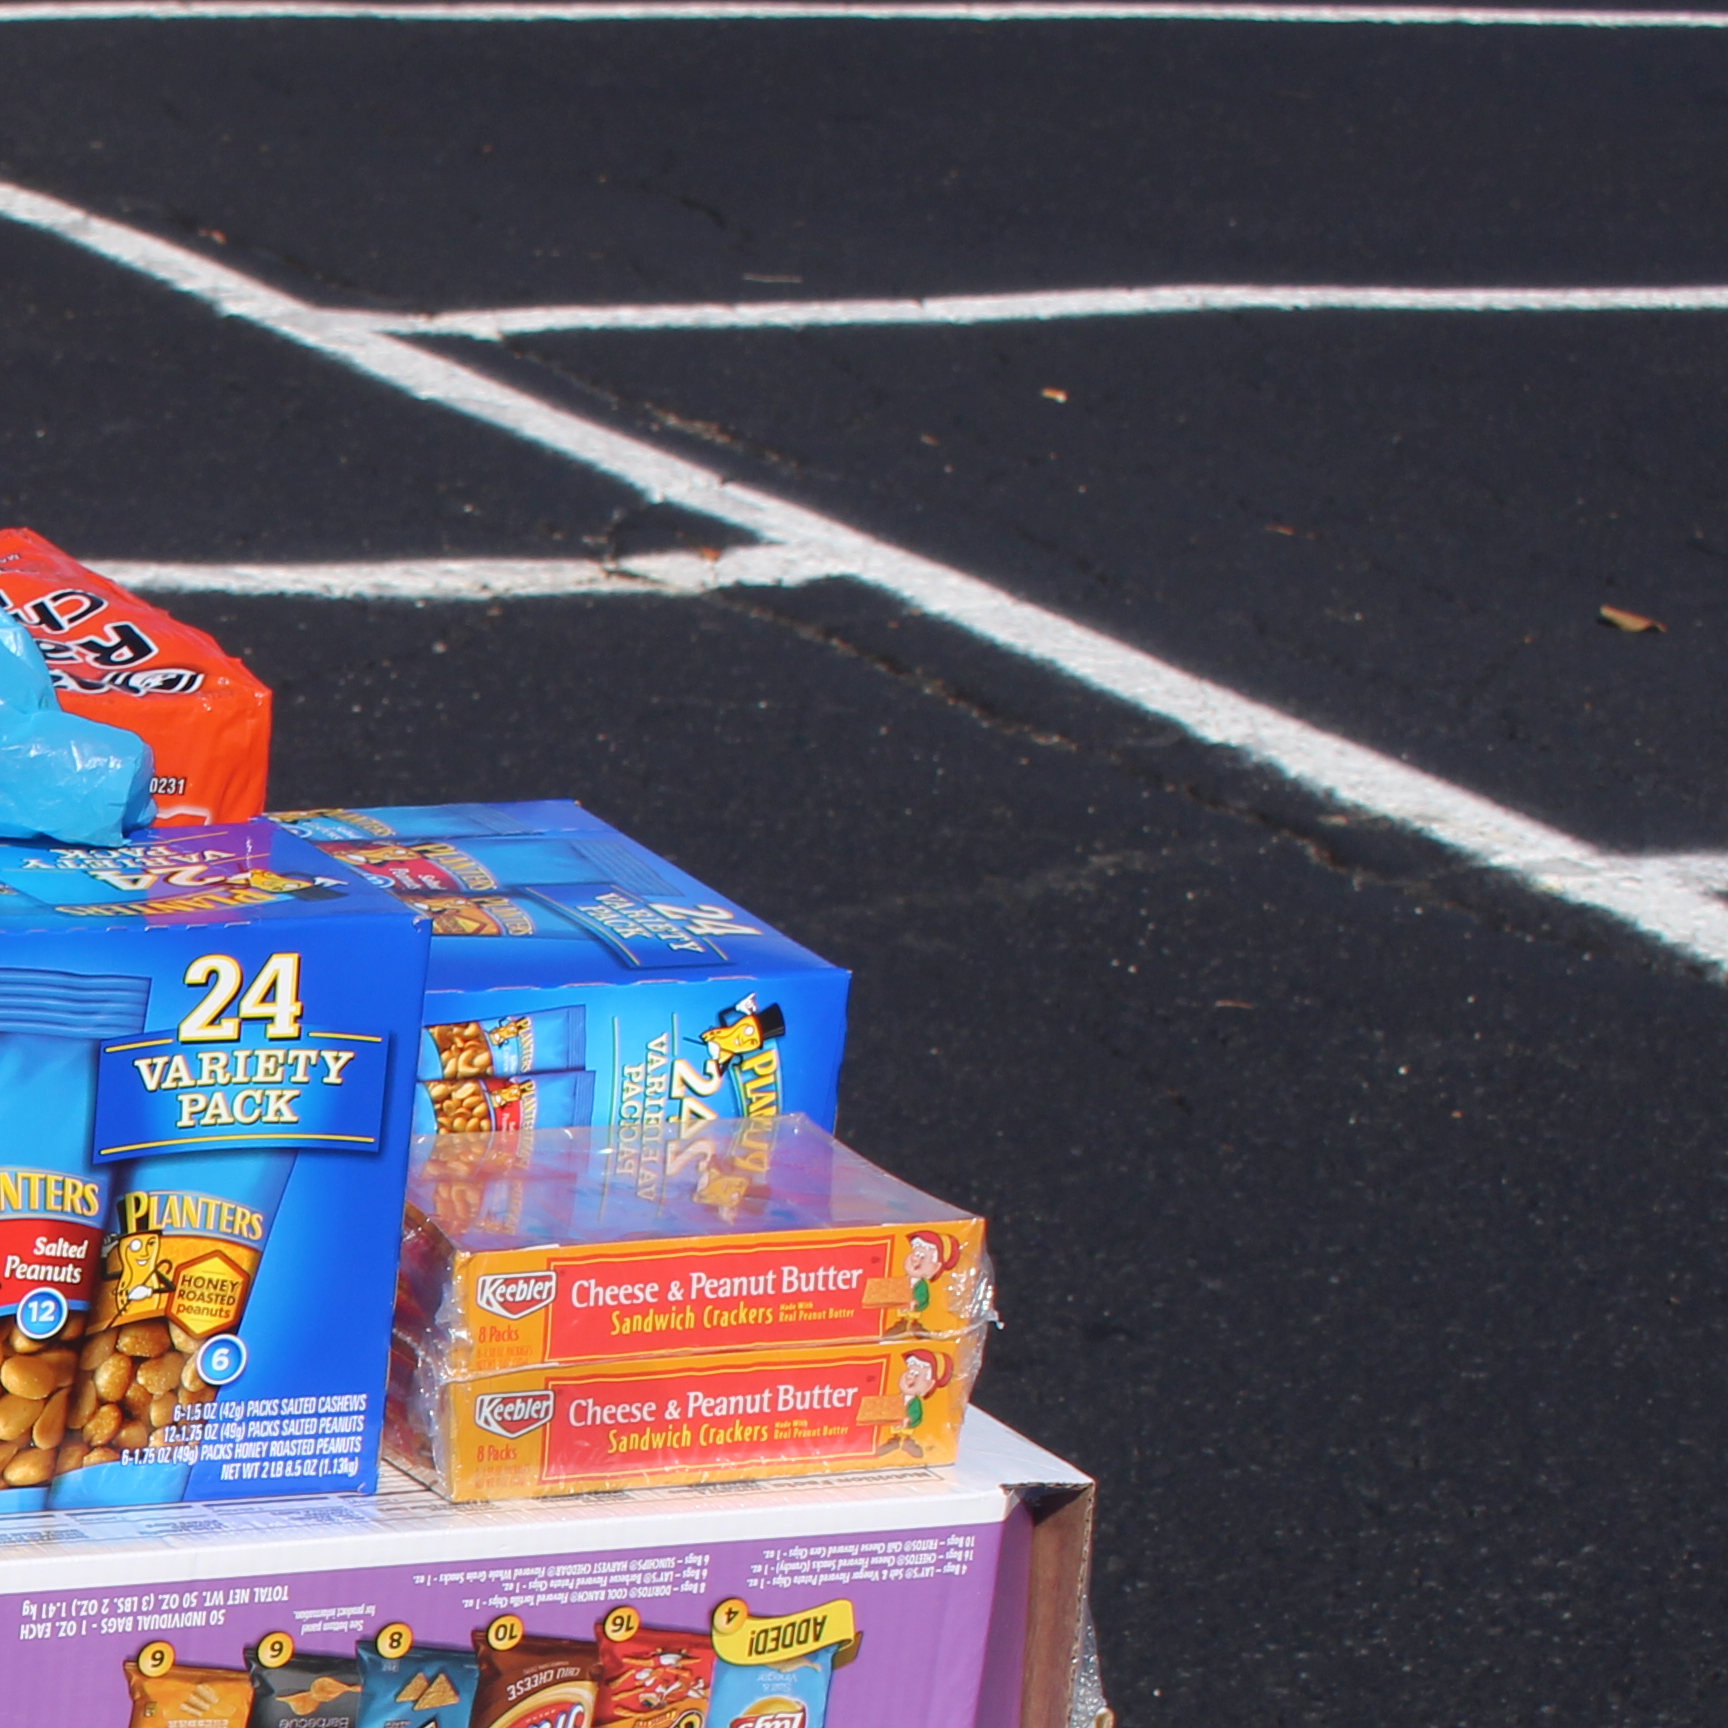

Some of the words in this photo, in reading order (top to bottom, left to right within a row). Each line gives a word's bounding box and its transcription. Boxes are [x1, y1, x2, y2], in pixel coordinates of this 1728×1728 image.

[575, 905, 656, 942] PACK
[592, 893, 707, 953] VARIETY
[647, 904, 762, 937] 24
[179, 954, 304, 1041] 24
[135, 1051, 356, 1091] VARIETY
[178, 1091, 299, 1127] PACK
[124, 1192, 264, 1239] PLANTERS
[34, 1237, 87, 1261] Salted
[6, 1257, 82, 1283] Peanuts
[181, 1274, 239, 1290] HONEY
[178, 1289, 238, 1306] ROASTED
[479, 1276, 554, 1305] Keebler
[572, 1278, 660, 1309] Cheese
[668, 1282, 684, 1300] &
[690, 1272, 776, 1299] Peanut
[782, 1266, 862, 1293] Butter
[28, 1300, 55, 1323] 12
[176, 1304, 231, 1321] peanuts
[610, 1308, 695, 1336] Sandwich
[703, 1304, 773, 1328] Crackers
[211, 1347, 229, 1369] 6
[173, 1403, 201, 1421] 6-1.5
[203, 1404, 216, 1420] OZ
[219, 1402, 246, 1420] (42g)
[248, 1399, 280, 1416] PACKS
[282, 1397, 317, 1415] SALTED
[318, 1394, 367, 1413] CASHEWS
[478, 1396, 554, 1424] Keebler
[568, 1398, 656, 1428] Cheese
[664, 1400, 682, 1420] &
[686, 1391, 770, 1418] Peanut
[776, 1384, 858, 1411] Butter
[607, 1427, 691, 1455] Sandwich
[699, 1423, 768, 1446] Crackers
[747, 1615, 827, 1656] ADDED!
